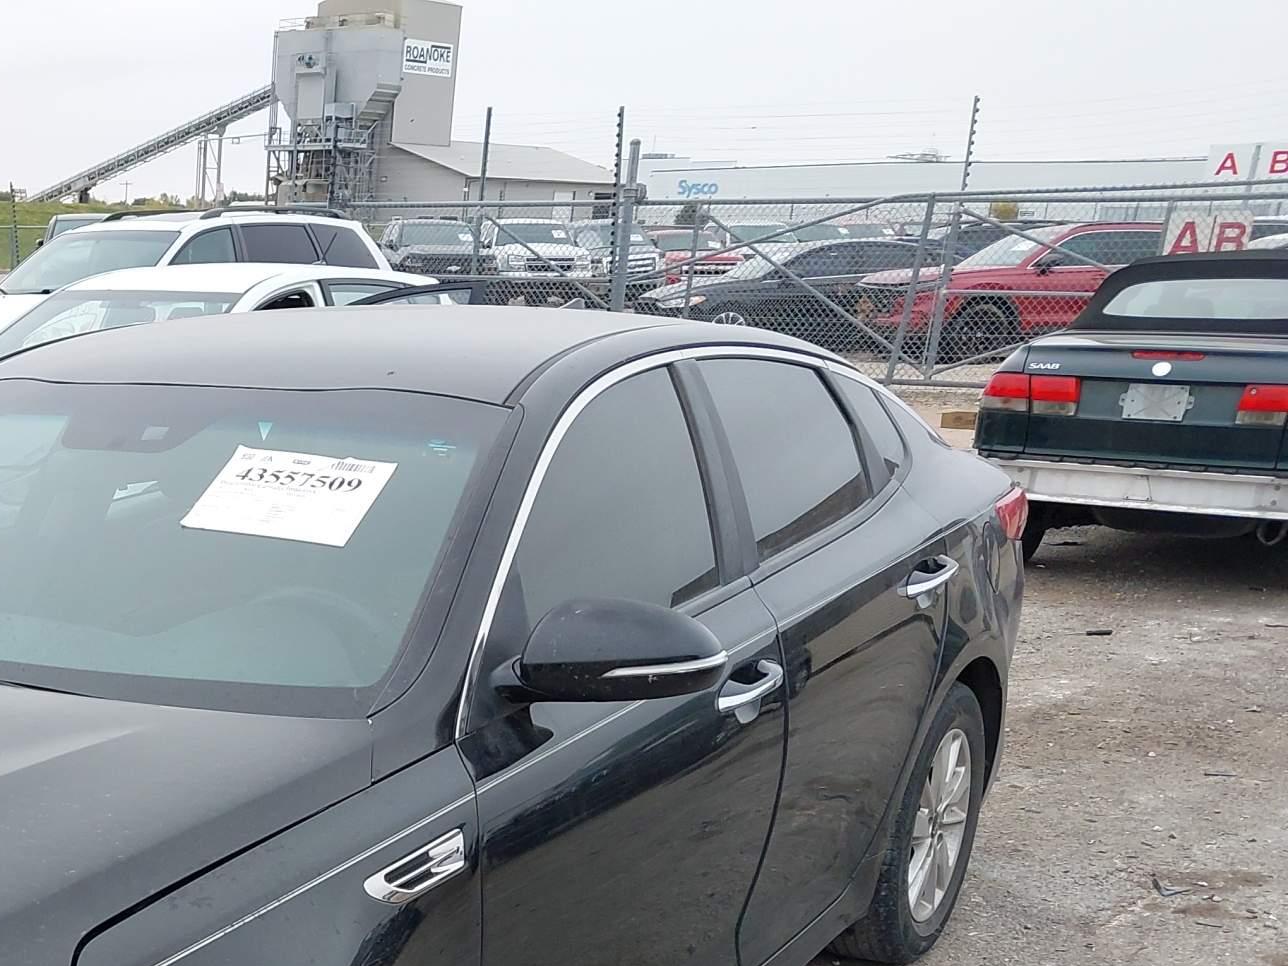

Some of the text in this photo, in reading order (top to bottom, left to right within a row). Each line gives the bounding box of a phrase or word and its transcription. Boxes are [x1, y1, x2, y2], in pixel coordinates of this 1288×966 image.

[406, 45, 451, 63] ROANOKE
[404, 64, 427, 73] CONCRETE
[1214, 152, 1238, 175] A
[677, 179, 719, 198] Sysco
[1028, 362, 1061, 370] SAAB
[235, 466, 363, 494] 43557509
